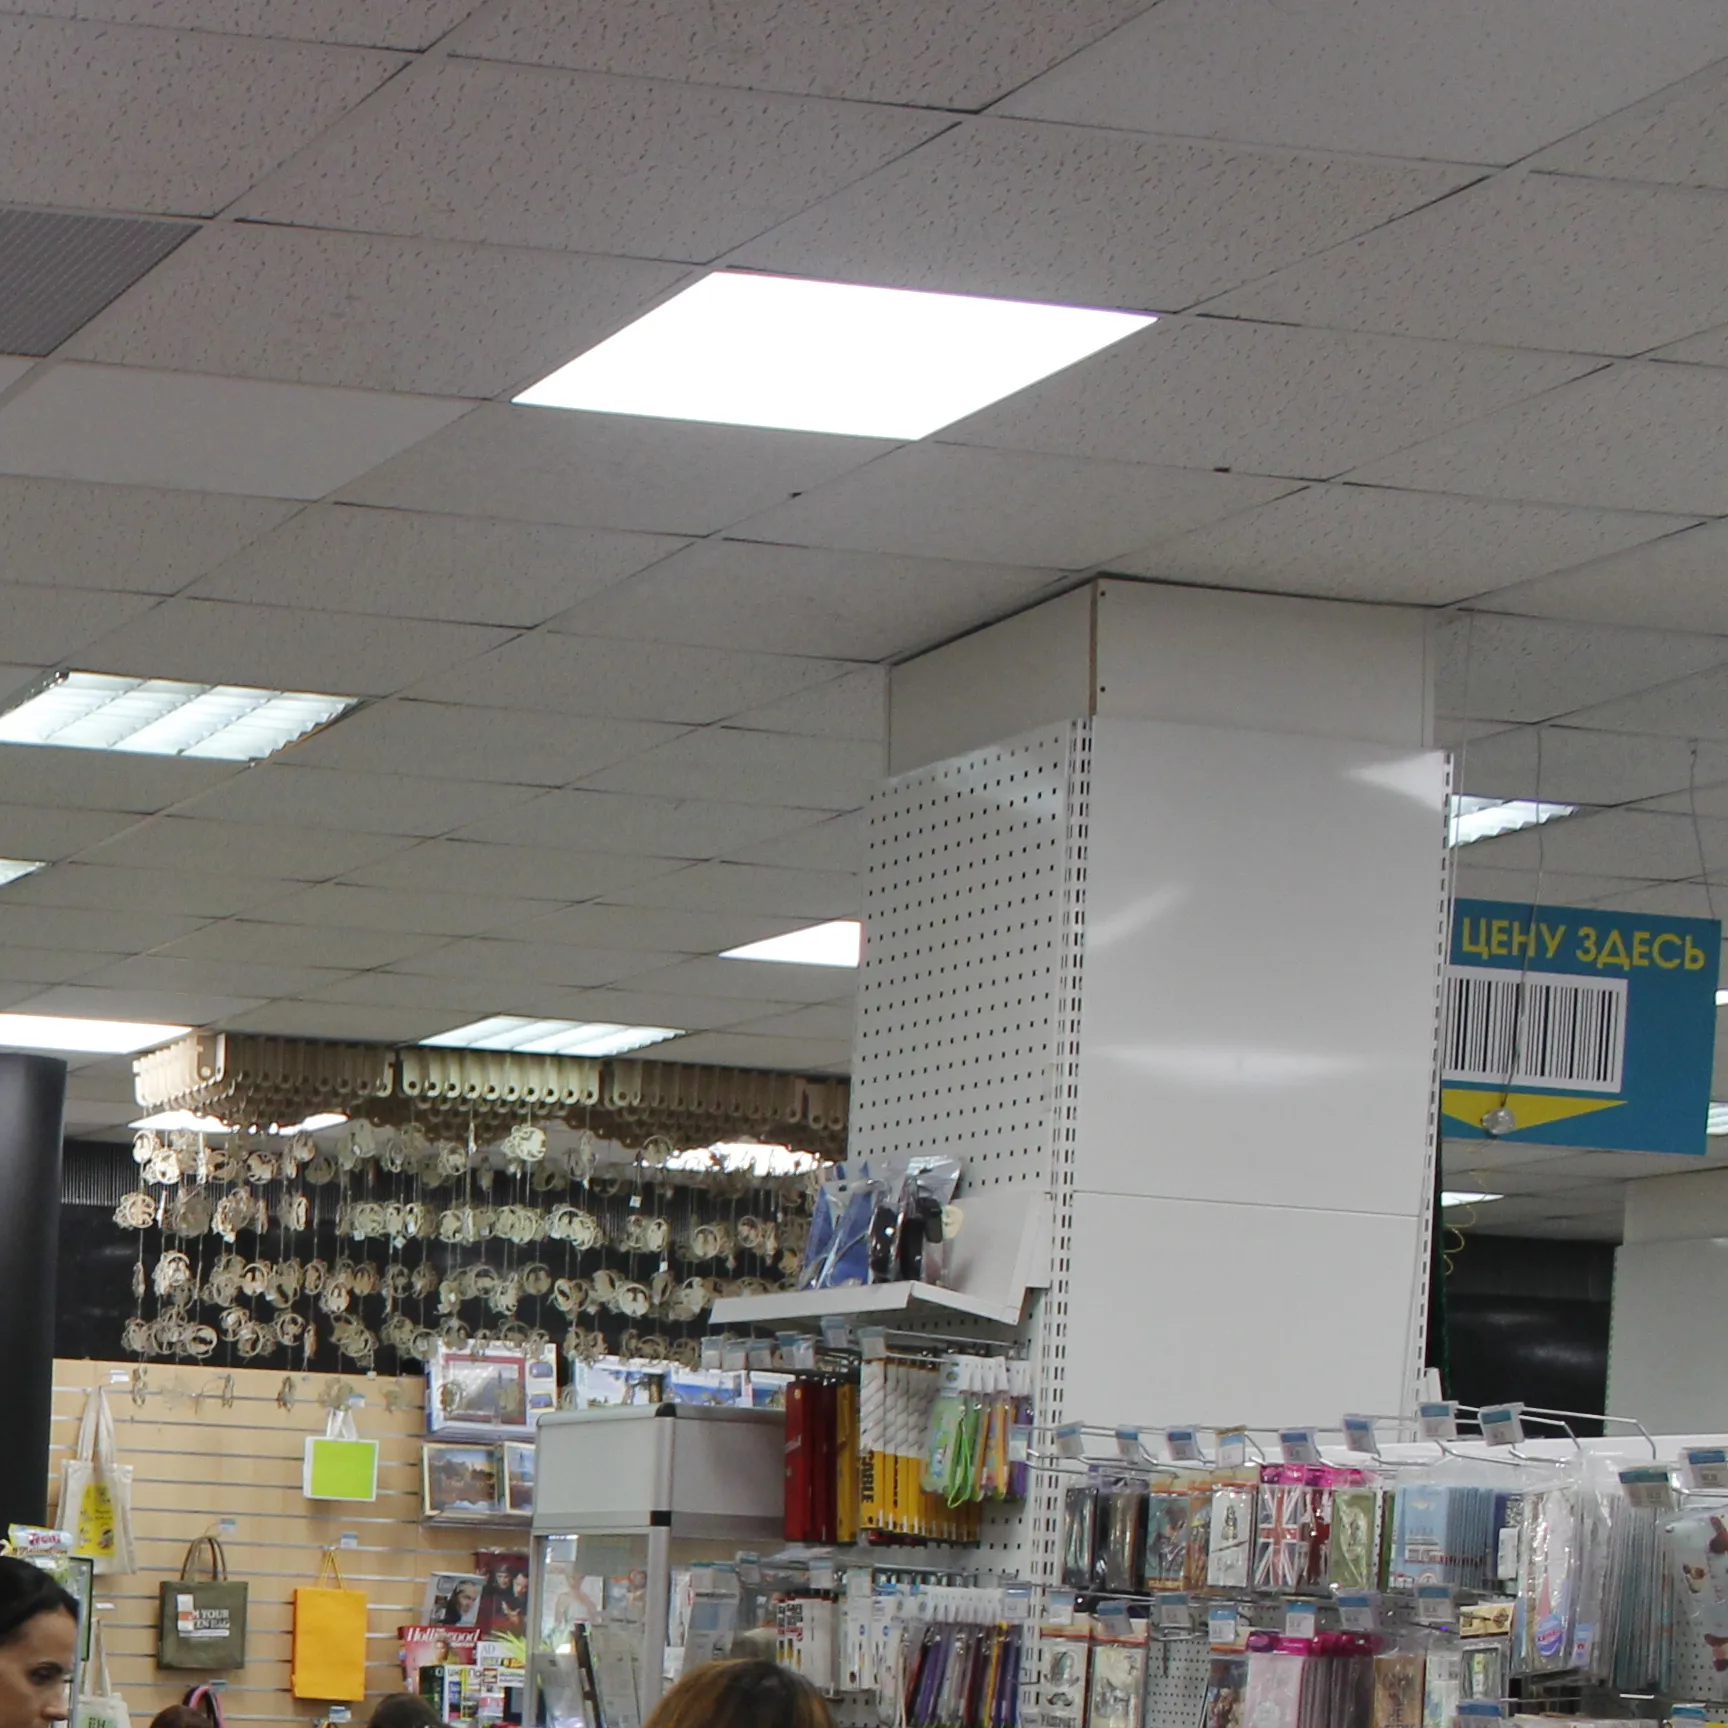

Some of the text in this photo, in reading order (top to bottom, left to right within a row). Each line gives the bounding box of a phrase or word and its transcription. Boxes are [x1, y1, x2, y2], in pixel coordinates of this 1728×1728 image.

[1461, 916, 1706, 971] ЦЕНУ ЗДЕСЬ
[201, 1609, 229, 1619] YOUR
[407, 1627, 481, 1642] Hollood
